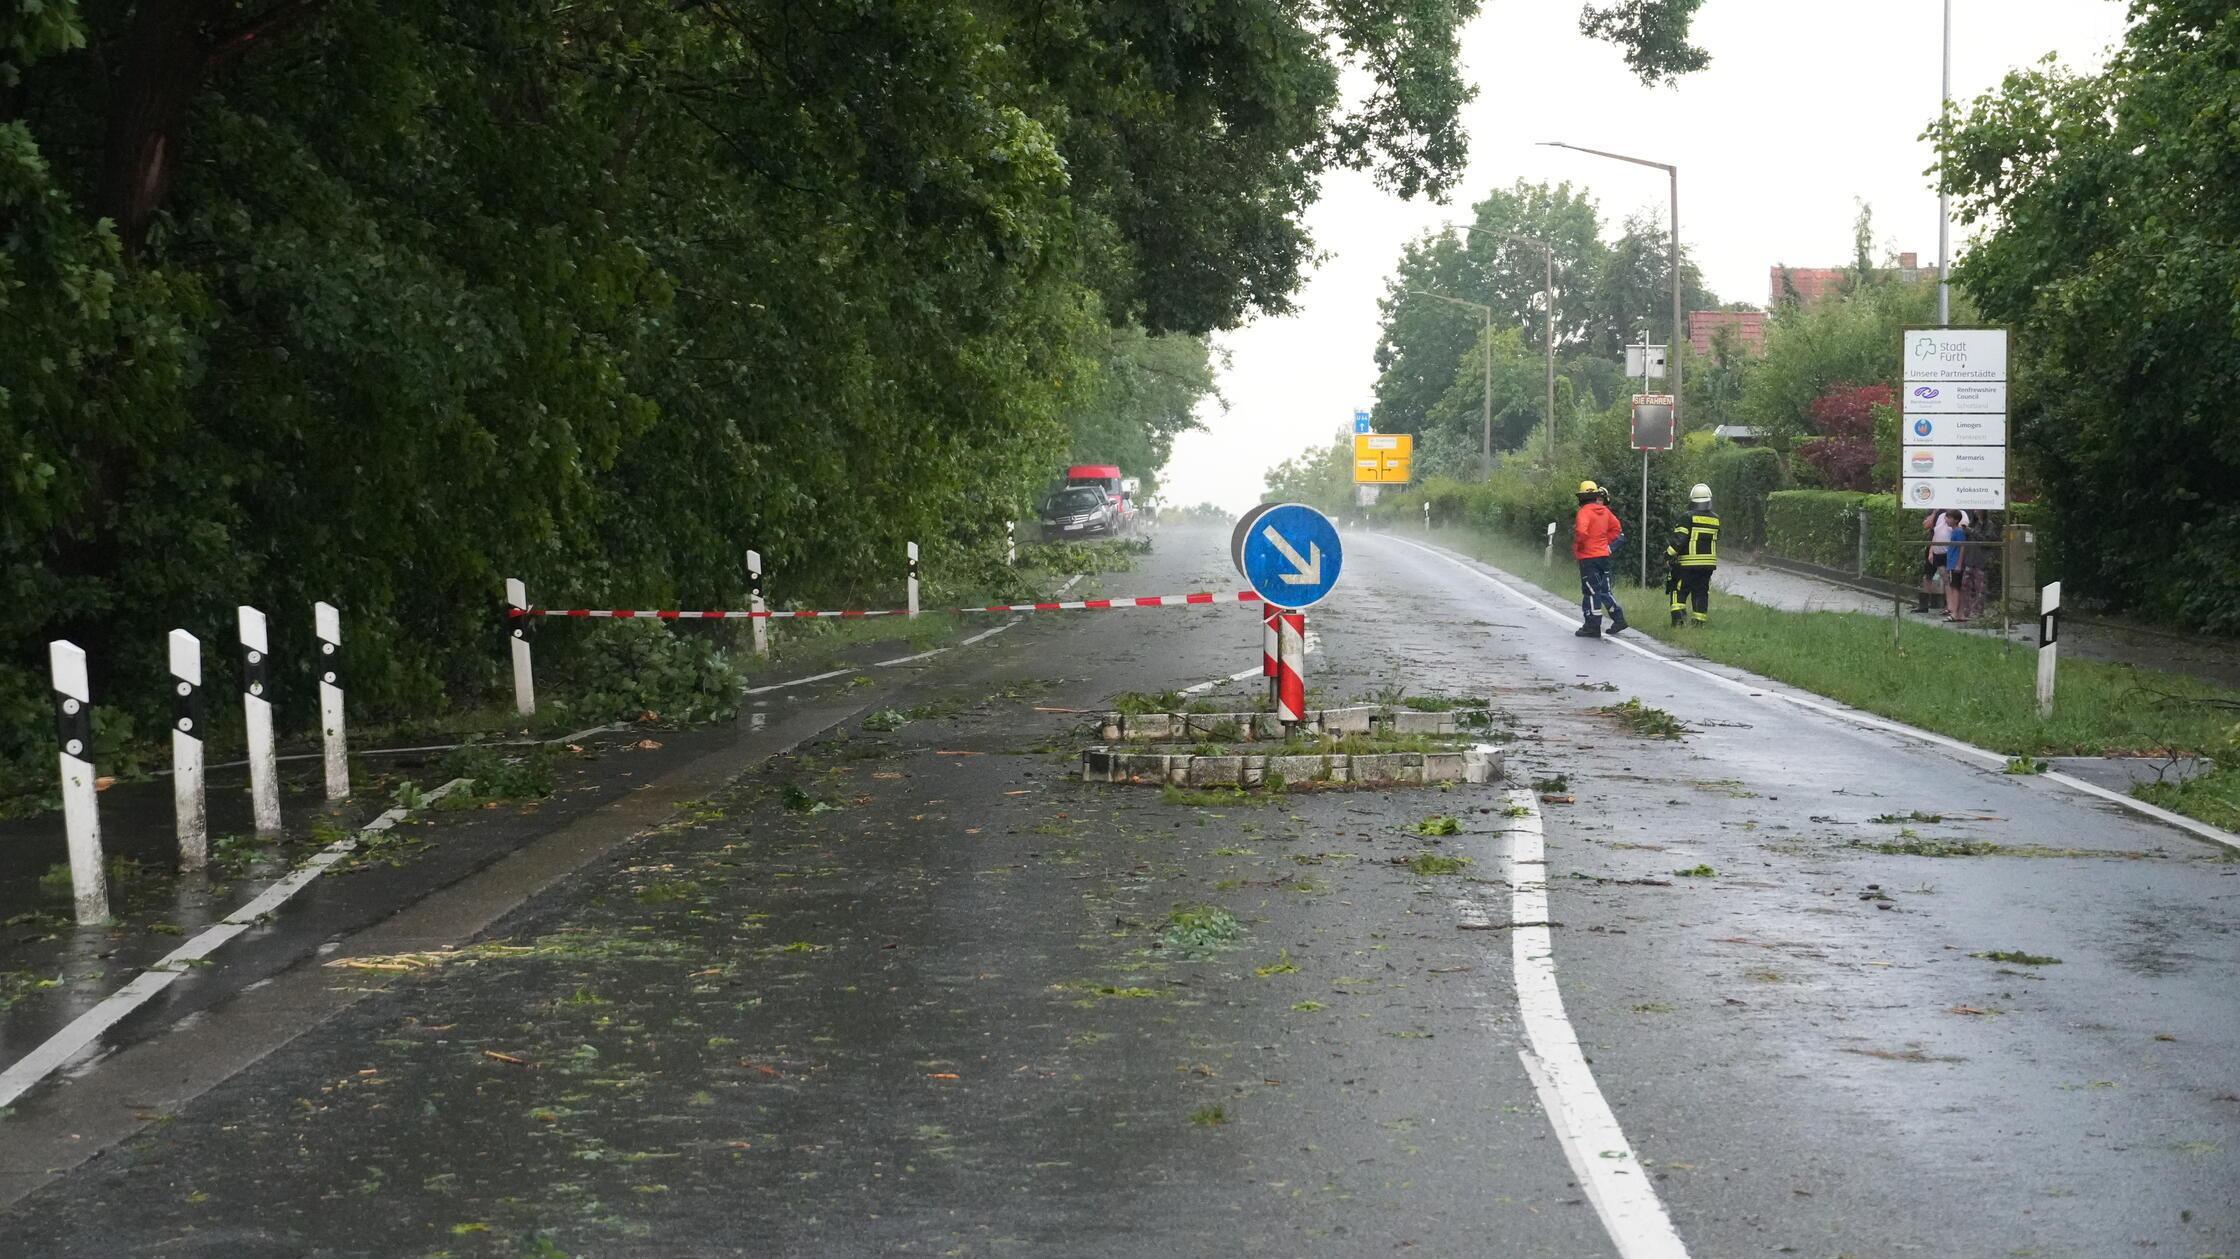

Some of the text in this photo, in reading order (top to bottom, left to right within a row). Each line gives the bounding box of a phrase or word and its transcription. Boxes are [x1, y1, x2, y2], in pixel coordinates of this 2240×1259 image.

[1940, 342, 1967, 352] Stadt
[1940, 352, 1967, 362] Fürth
[1910, 369, 1996, 378] Unsere Partnerstädte
[1634, 397, 1672, 405] SIE FAHREN
[1956, 422, 1982, 430] Limoges
